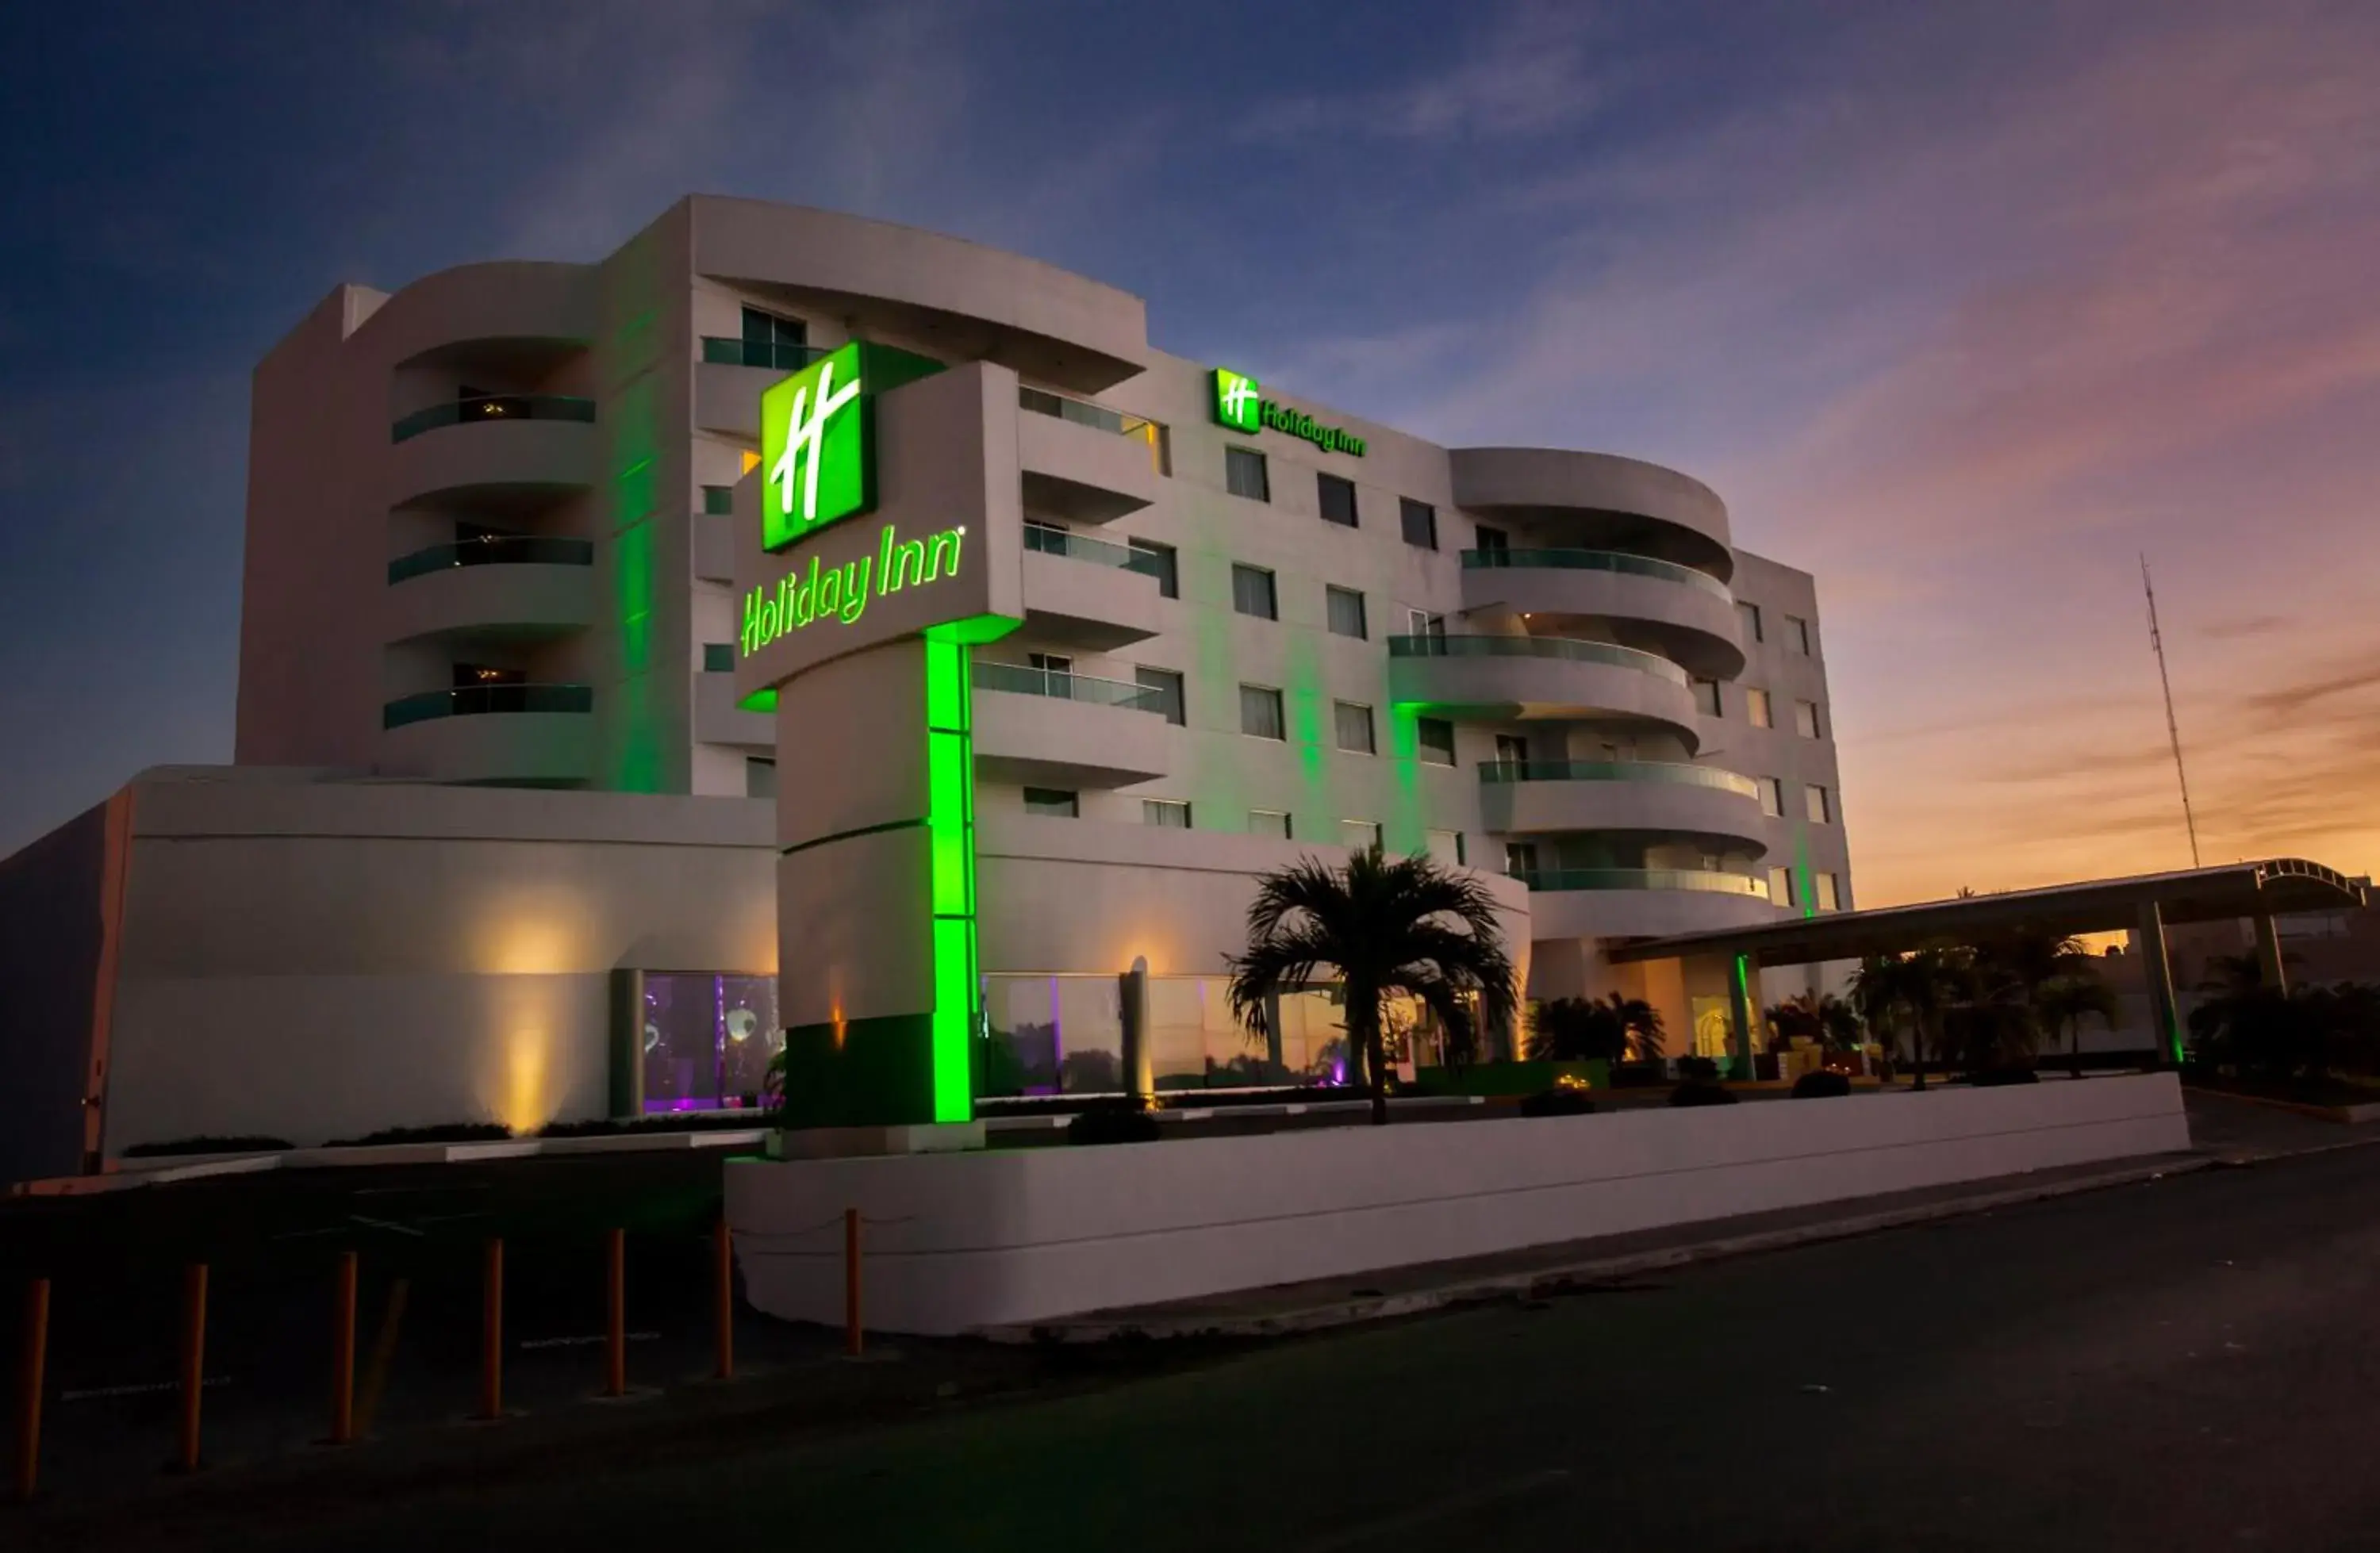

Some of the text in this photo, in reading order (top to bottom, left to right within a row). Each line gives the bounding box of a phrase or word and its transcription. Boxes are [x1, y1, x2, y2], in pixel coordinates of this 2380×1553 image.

[770, 362, 861, 520] H
[1262, 401, 1368, 457] Holiday Inn
[740, 525, 962, 658] Holiday Inn
